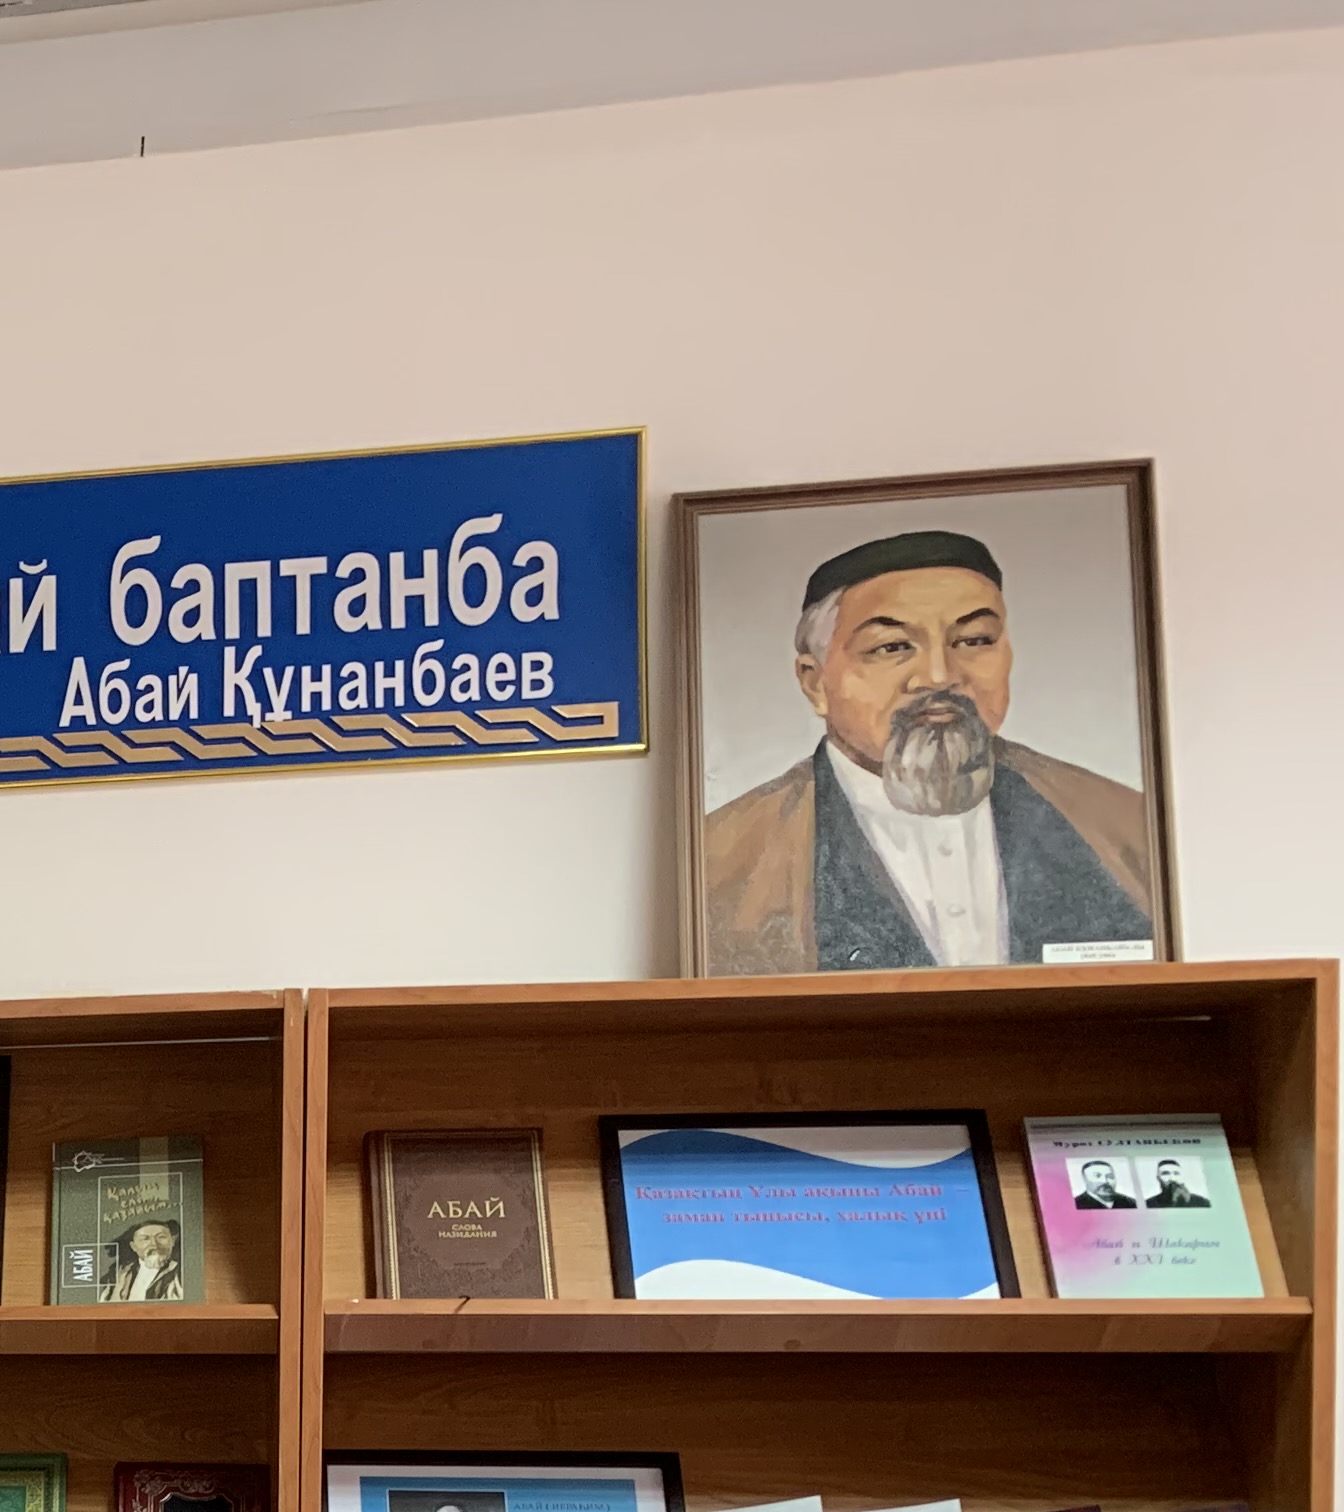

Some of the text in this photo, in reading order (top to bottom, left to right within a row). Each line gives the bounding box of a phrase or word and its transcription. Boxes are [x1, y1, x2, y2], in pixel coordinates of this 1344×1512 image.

[108, 512, 562, 650] баптанба
[59, 636, 555, 728] Абай Құнанбаев
[887, 1183, 944, 1197] Абай
[427, 1196, 506, 1219] АБАЙ
[438, 1230, 497, 1238] НАЗИДАНИЯ
[451, 1223, 483, 1231] СЛОВА
[69, 1249, 93, 1282] АБАЙ
